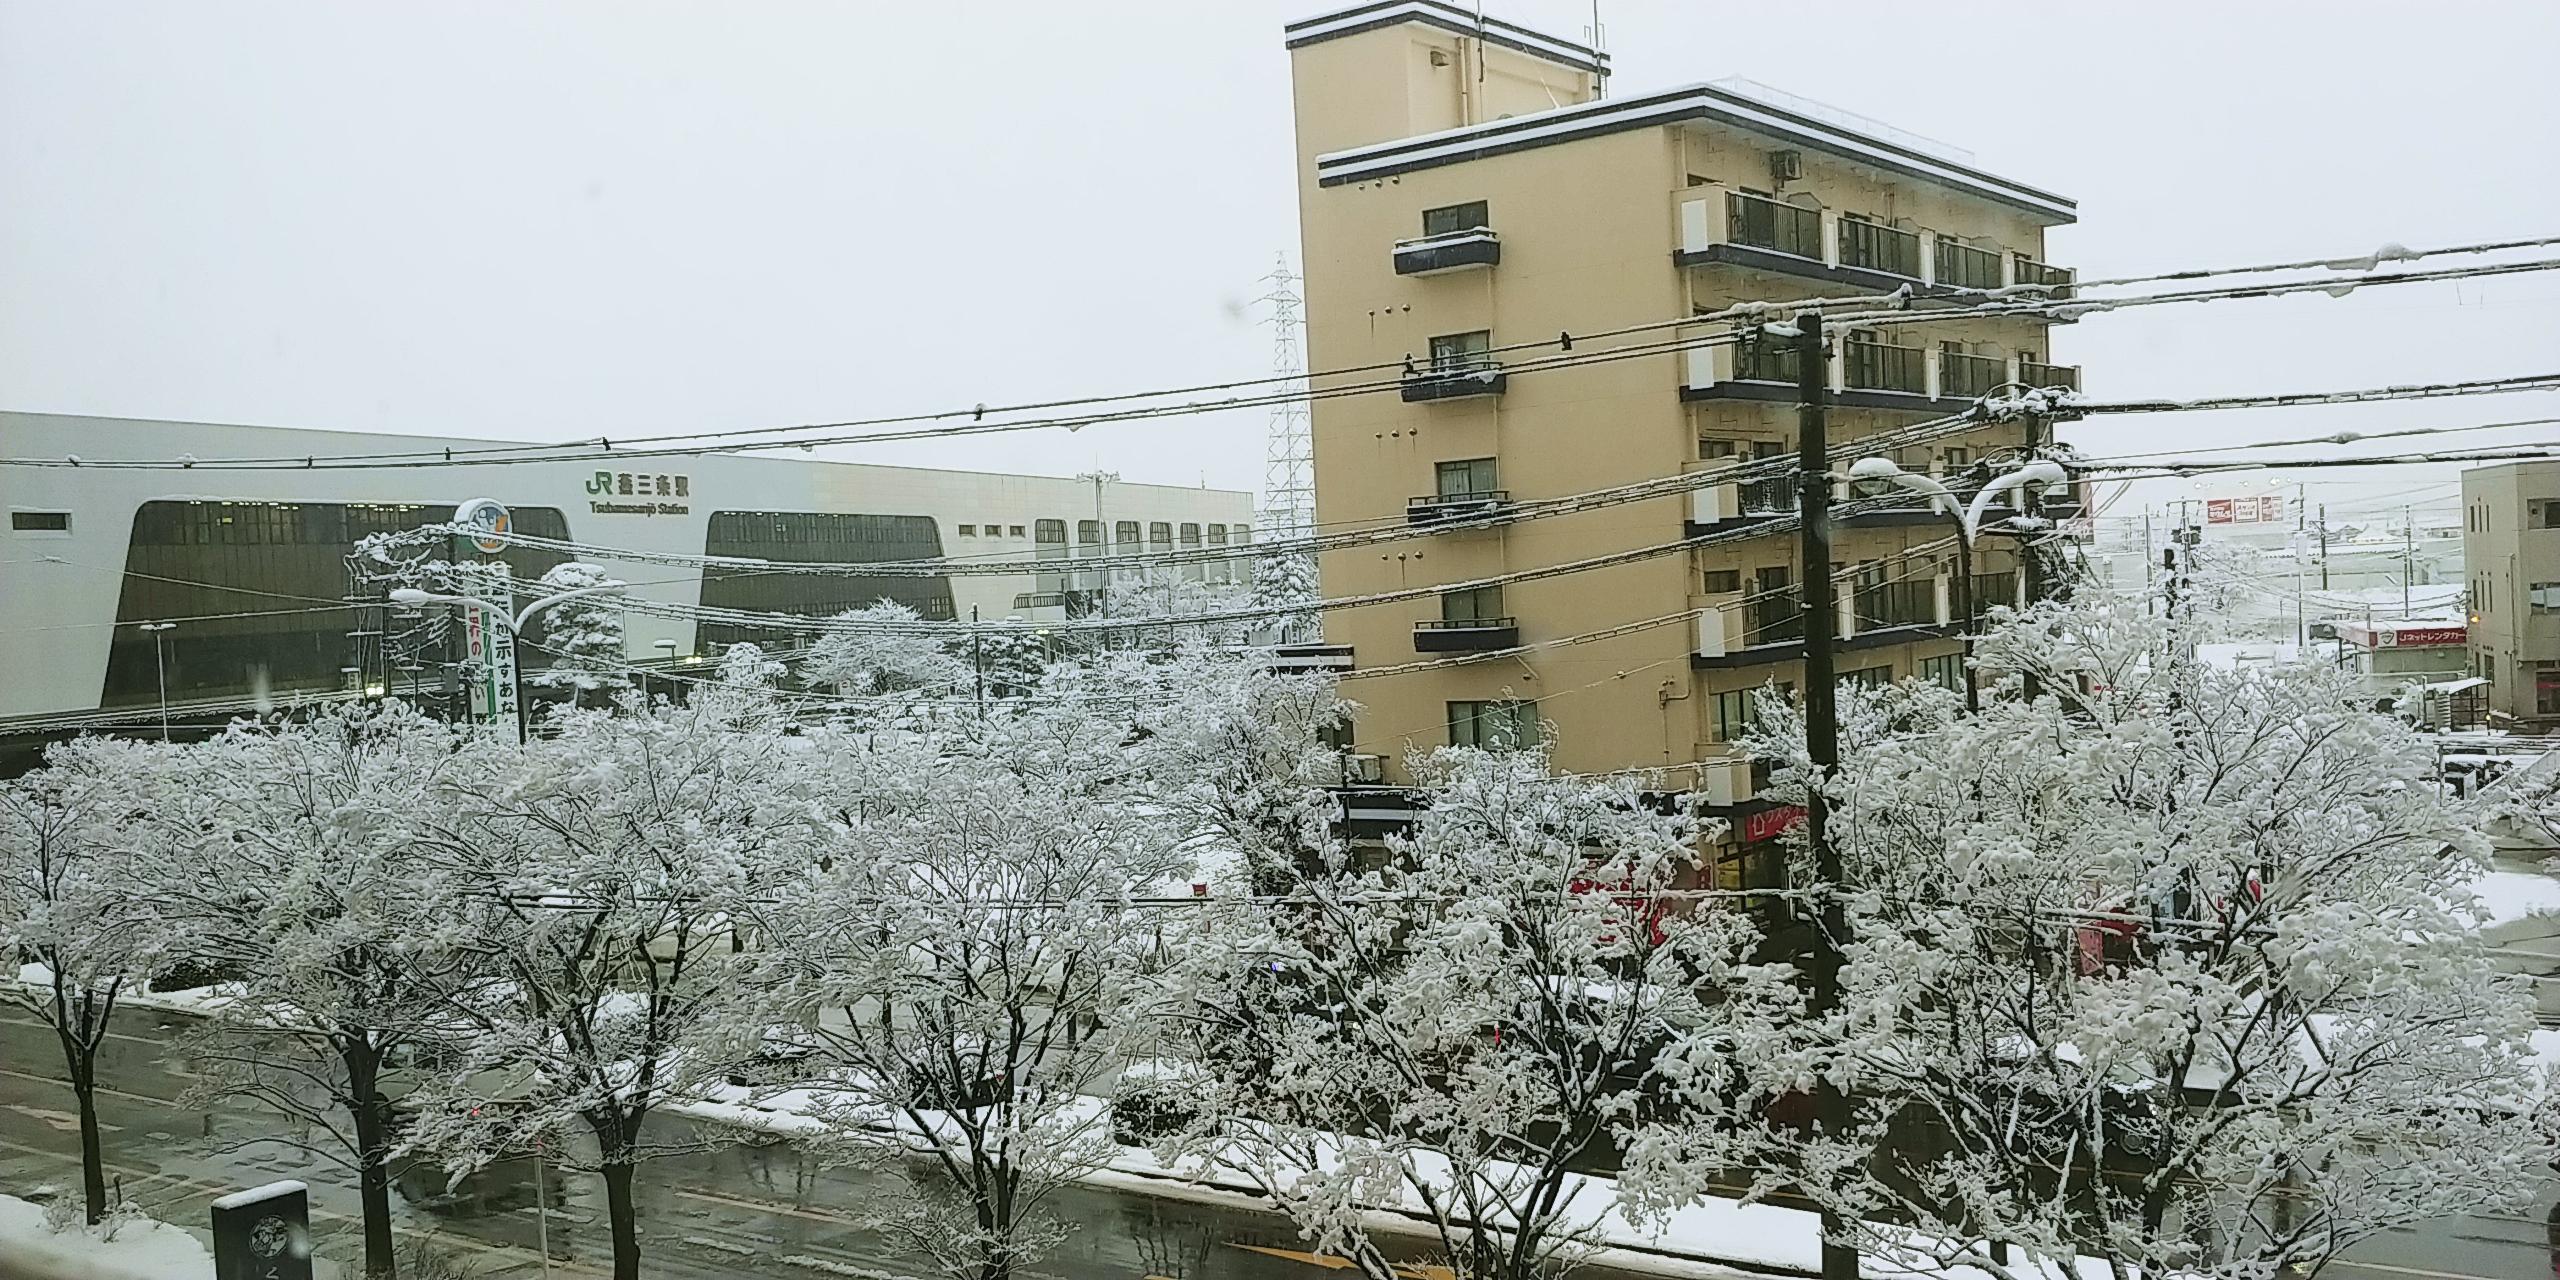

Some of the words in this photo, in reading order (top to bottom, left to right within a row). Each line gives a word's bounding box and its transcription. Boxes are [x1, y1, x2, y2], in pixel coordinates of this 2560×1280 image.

[586, 471, 613, 495] JR
[658, 503, 689, 514] Station
[2400, 631, 2466, 642] Jネットレンタカー
